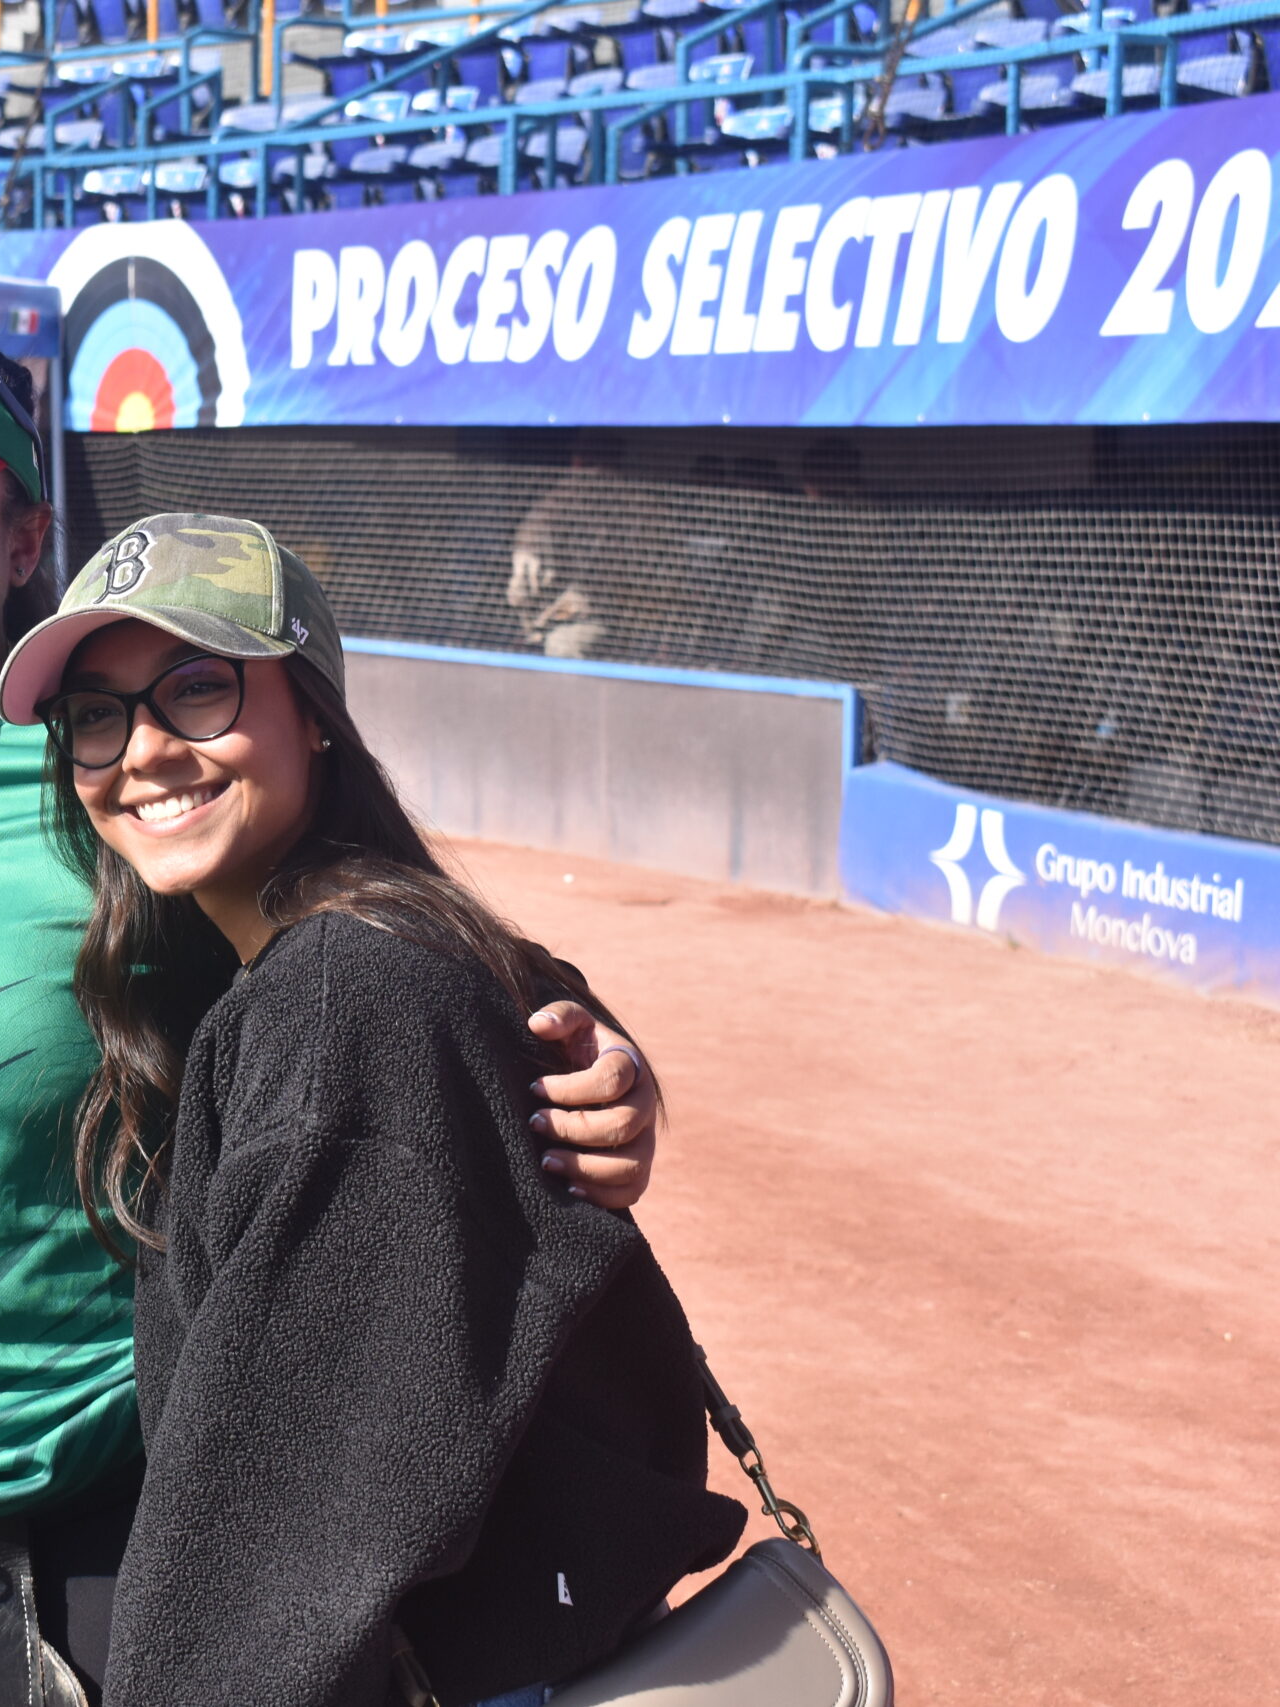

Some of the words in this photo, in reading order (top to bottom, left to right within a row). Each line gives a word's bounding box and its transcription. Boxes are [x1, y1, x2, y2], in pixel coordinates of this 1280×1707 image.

[290, 225, 617, 370] PROCESO
[626, 173, 1079, 359] SELECTIVO
[1099, 148, 1280, 338] 20
[93, 529, 157, 604] B
[1035, 843, 1116, 898] Grupo
[1122, 860, 1244, 922] Industrial
[1070, 902, 1198, 965] Monclova
